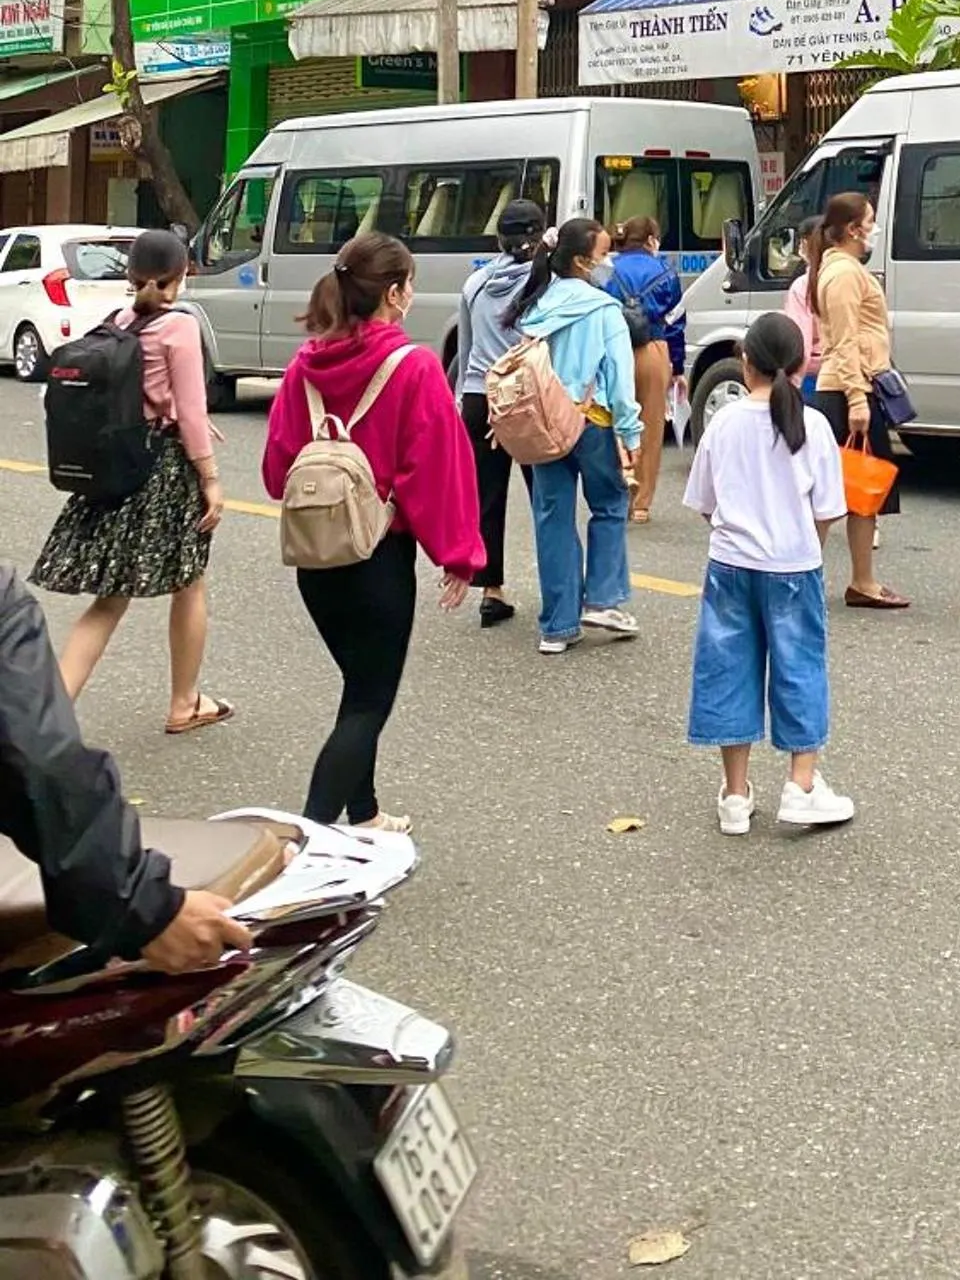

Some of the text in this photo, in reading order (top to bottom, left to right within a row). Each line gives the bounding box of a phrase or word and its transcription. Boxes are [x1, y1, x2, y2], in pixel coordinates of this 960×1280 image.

[629, 6, 728, 38] THÀNH TIẾN
[786, 53, 803, 65] 71
[811, 48, 845, 63] YÊN
